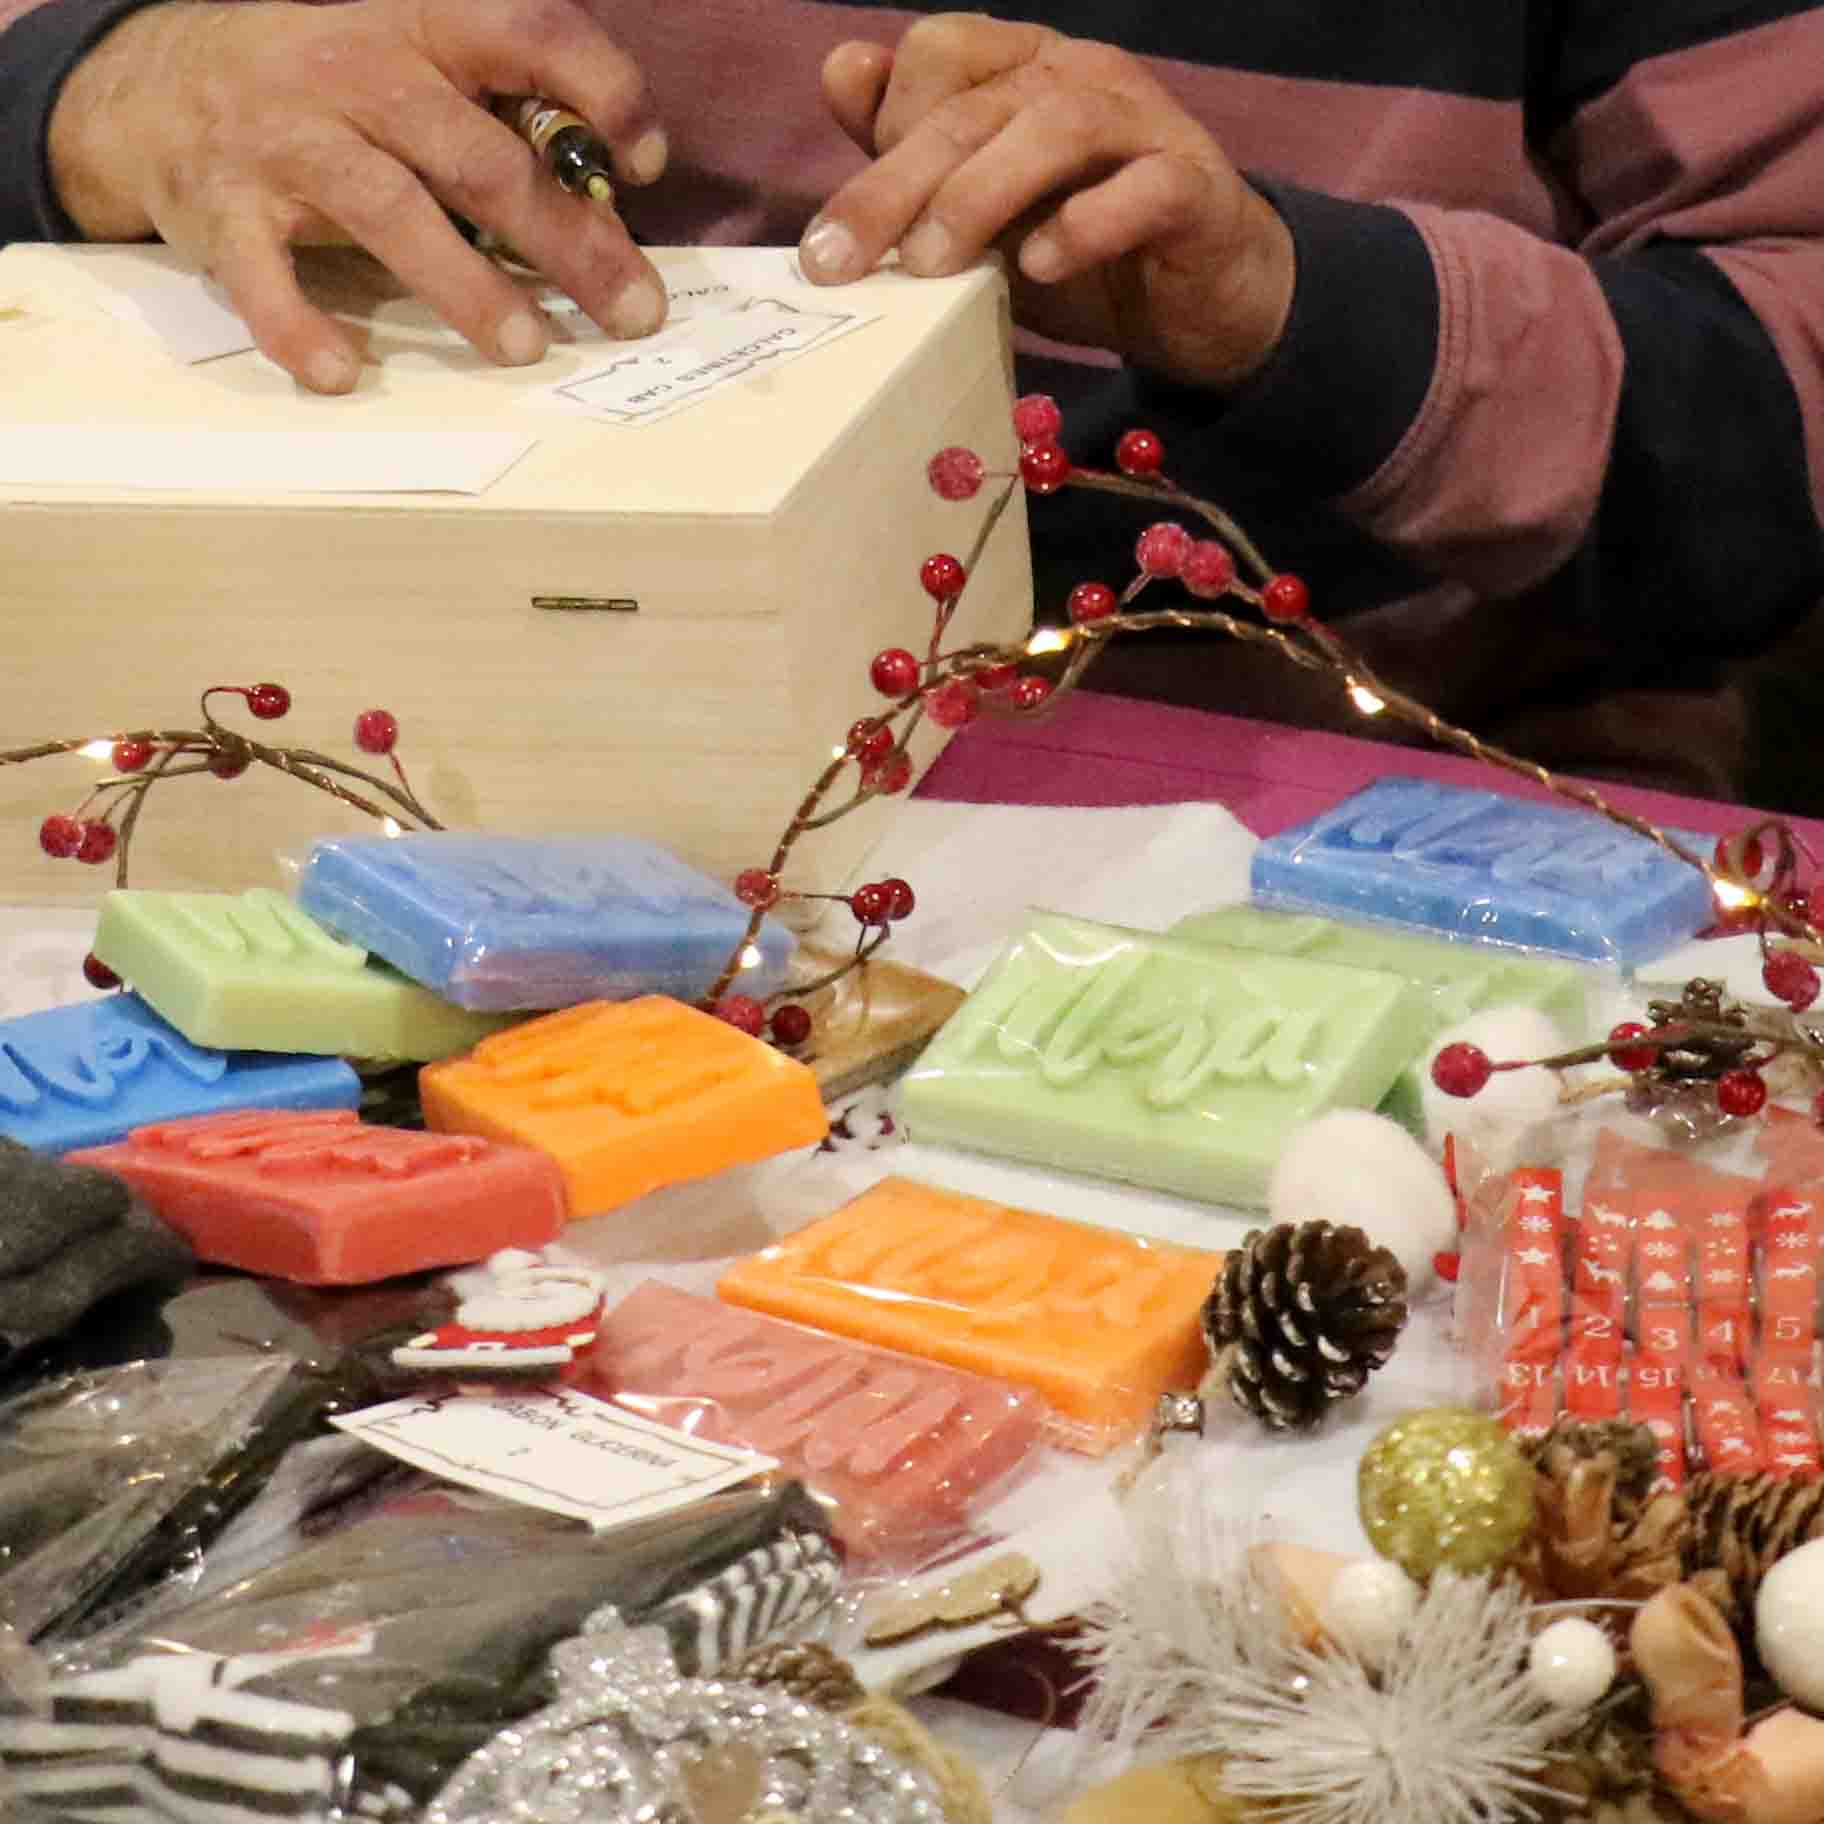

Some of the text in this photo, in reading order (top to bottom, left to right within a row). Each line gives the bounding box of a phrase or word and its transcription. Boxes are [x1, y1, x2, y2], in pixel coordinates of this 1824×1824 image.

[1582, 1314, 1614, 1339] 2
[1705, 1320, 1736, 1344] 4
[1774, 1316, 1802, 1340] 5
[1649, 1328, 1679, 1352] 3
[1506, 1362, 1545, 1389] 13
[1574, 1363, 1611, 1389] 14
[1638, 1366, 1677, 1390] 15
